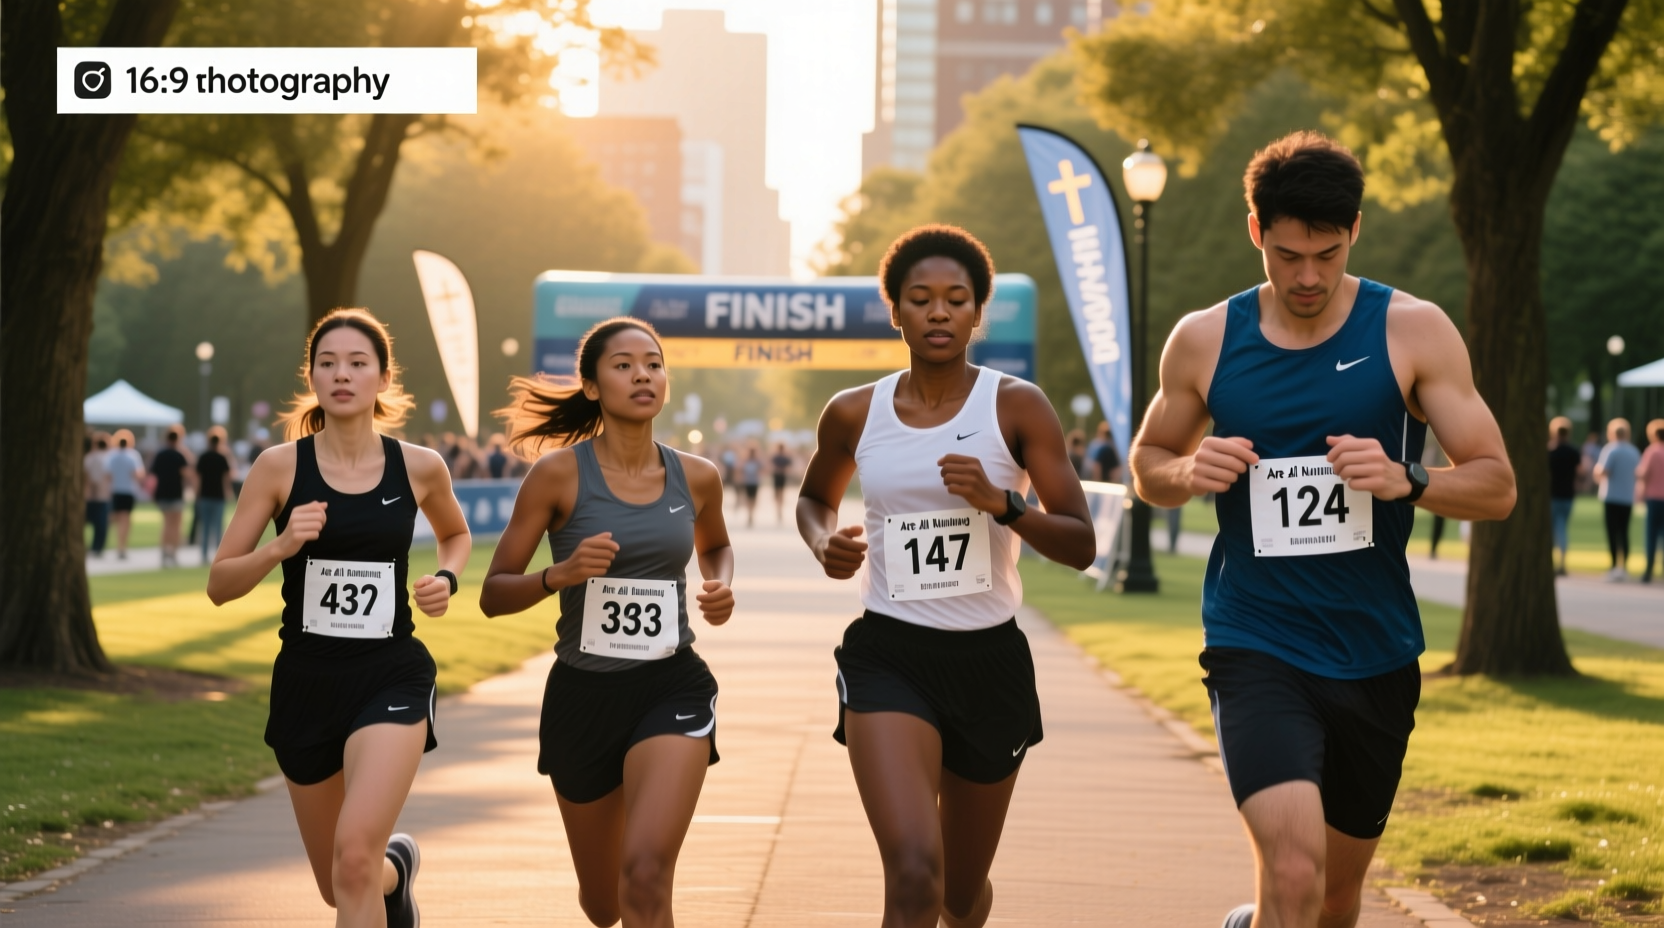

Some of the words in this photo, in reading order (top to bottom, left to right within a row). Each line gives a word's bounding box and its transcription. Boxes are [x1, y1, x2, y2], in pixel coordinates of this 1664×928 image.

[705, 292, 846, 331] FINISH
[734, 340, 813, 361] FINISH
[1272, 483, 1350, 528] 124
[904, 533, 971, 575] 147
